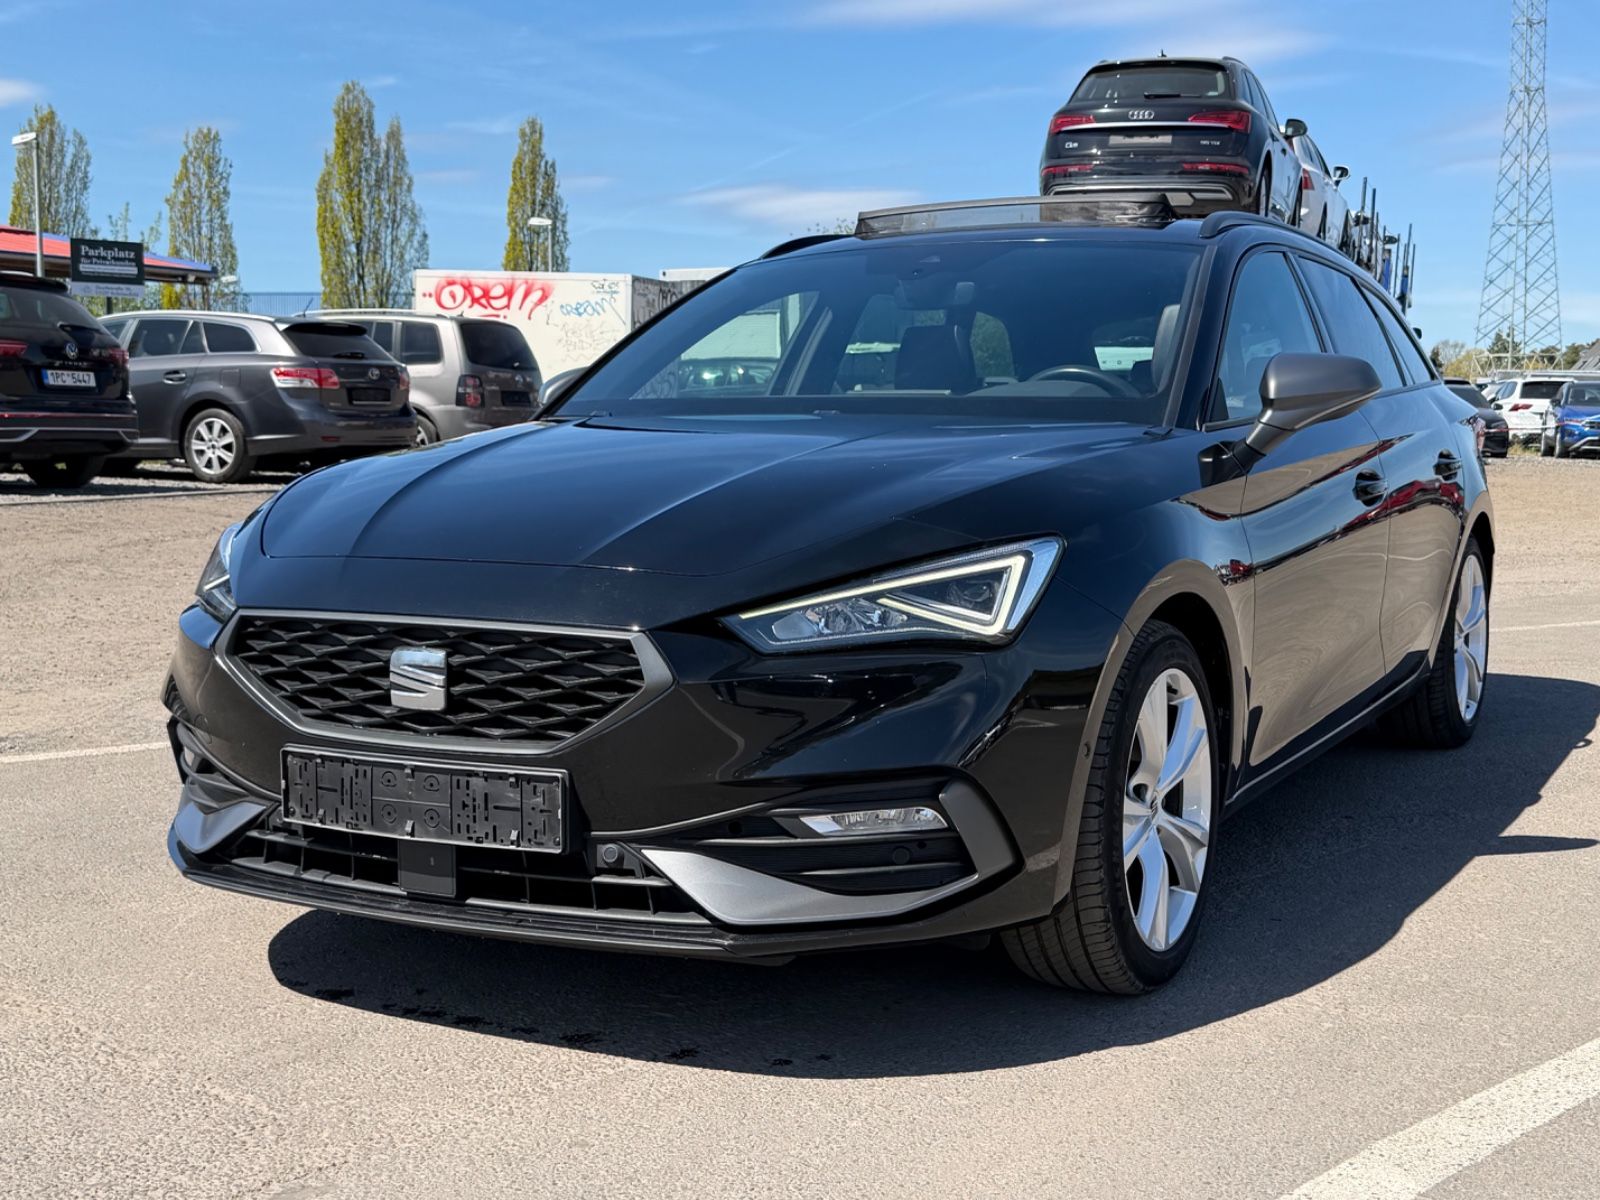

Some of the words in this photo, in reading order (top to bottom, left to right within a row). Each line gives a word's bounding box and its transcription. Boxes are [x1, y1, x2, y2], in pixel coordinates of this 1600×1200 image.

[80, 245, 136, 260] Parkplatz
[50, 371, 67, 384] 1PC
[71, 372, 92, 385] 5447
